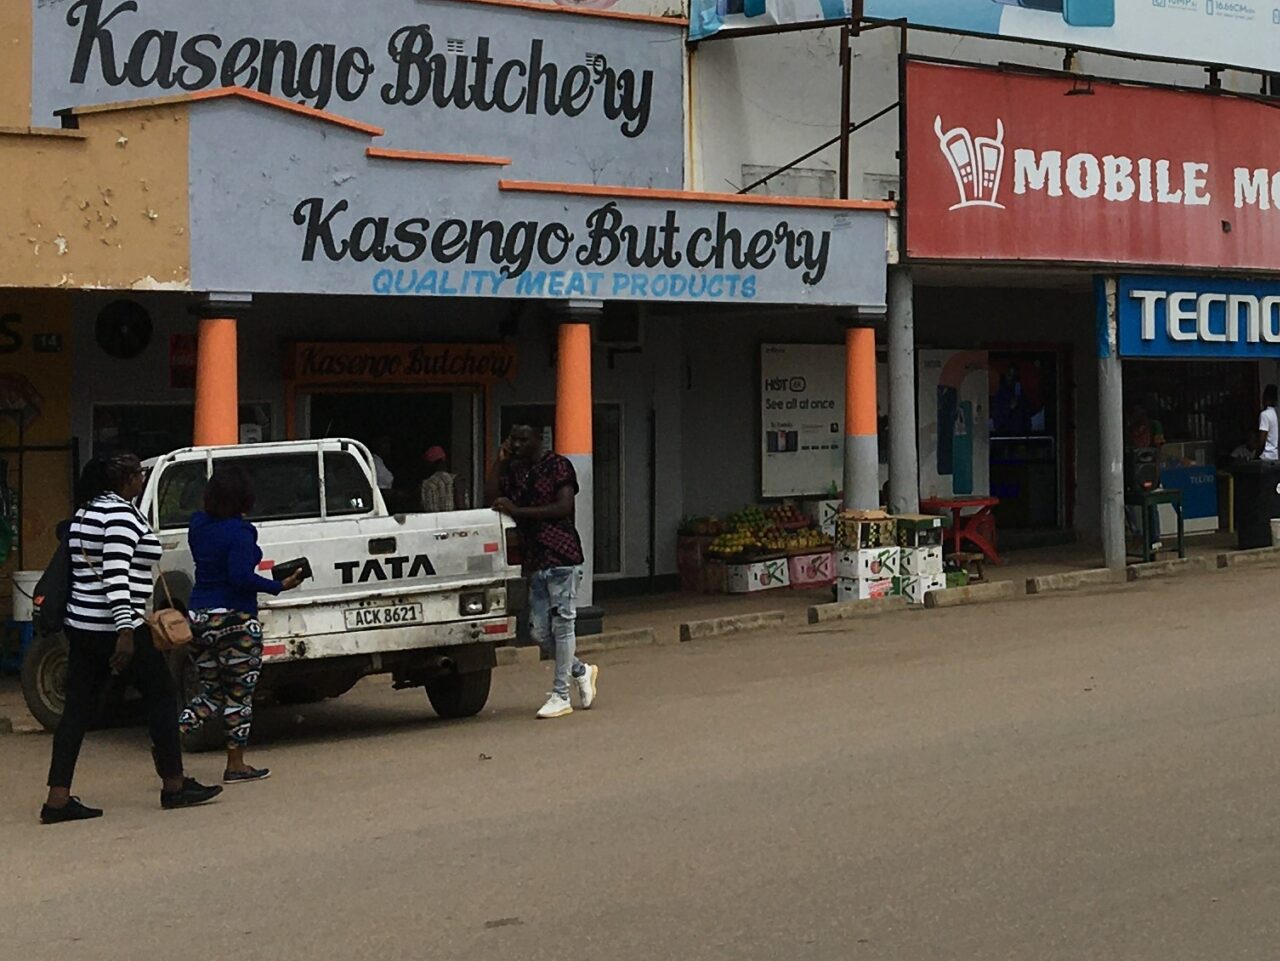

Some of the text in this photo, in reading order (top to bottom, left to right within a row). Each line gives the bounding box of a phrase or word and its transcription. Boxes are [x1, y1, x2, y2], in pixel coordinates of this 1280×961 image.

[380, 23, 654, 139] Butchery
[1012, 147, 1211, 207] MOBILE
[293, 196, 832, 286] Kasengo Butchery
[371, 267, 757, 300] QUALITY MEAT PRODUCTS
[302, 346, 401, 378] Kasengo
[766, 398, 835, 410] See all at once
[334, 553, 437, 585] TATA
[355, 606, 417, 627] ACK 8621
